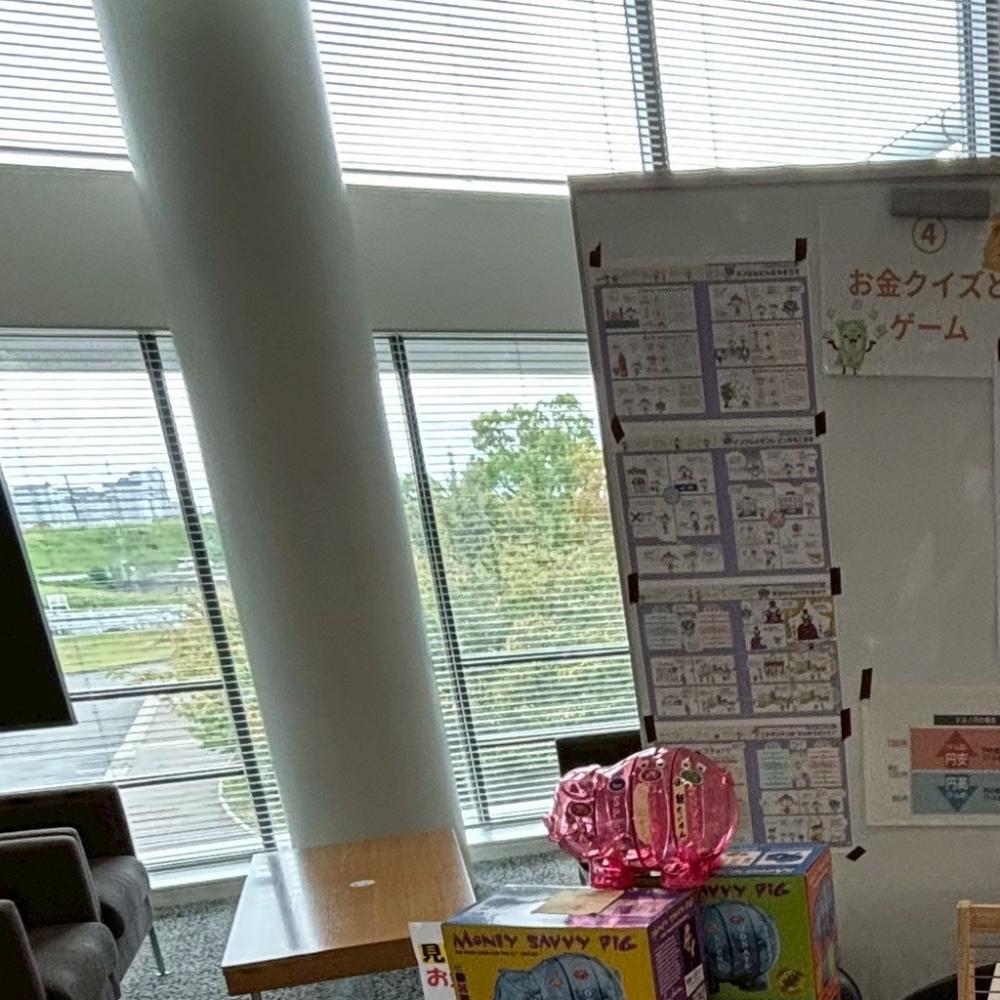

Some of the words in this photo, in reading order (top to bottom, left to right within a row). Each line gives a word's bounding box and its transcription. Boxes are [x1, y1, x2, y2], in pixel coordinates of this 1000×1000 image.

[889, 313, 969, 342] ゲーム
[755, 882, 792, 897] PIG
[453, 930, 518, 950] MONEY
[526, 934, 591, 950] SAVVY
[600, 935, 637, 951] PIG
